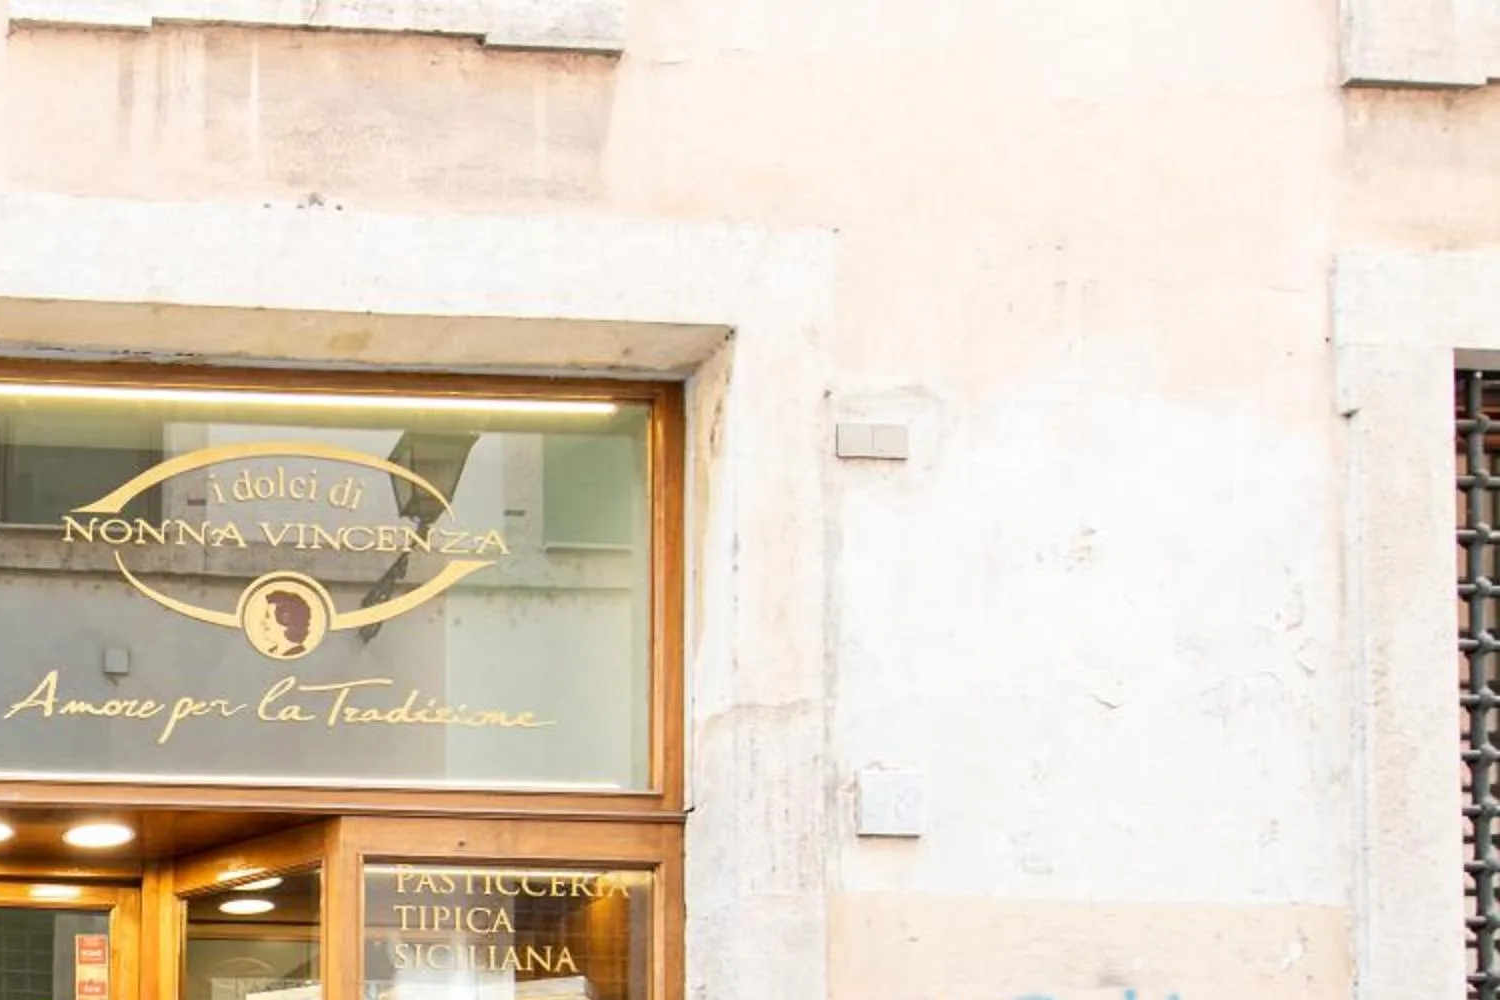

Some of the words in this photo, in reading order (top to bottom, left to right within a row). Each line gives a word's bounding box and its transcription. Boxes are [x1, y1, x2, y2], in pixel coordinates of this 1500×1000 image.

[209, 473, 224, 504] i
[231, 466, 318, 502] dolci
[328, 472, 364, 510] di
[61, 514, 247, 549] NONNA
[257, 521, 511, 556] VINCENZA
[3, 669, 165, 719] Amore
[156, 696, 248, 744] per
[257, 675, 316, 722] la
[298, 677, 558, 728] Tradizione
[393, 864, 631, 898] PASTICCERIA
[393, 905, 516, 934] TIPICA
[393, 942, 581, 973] SICILIANA
